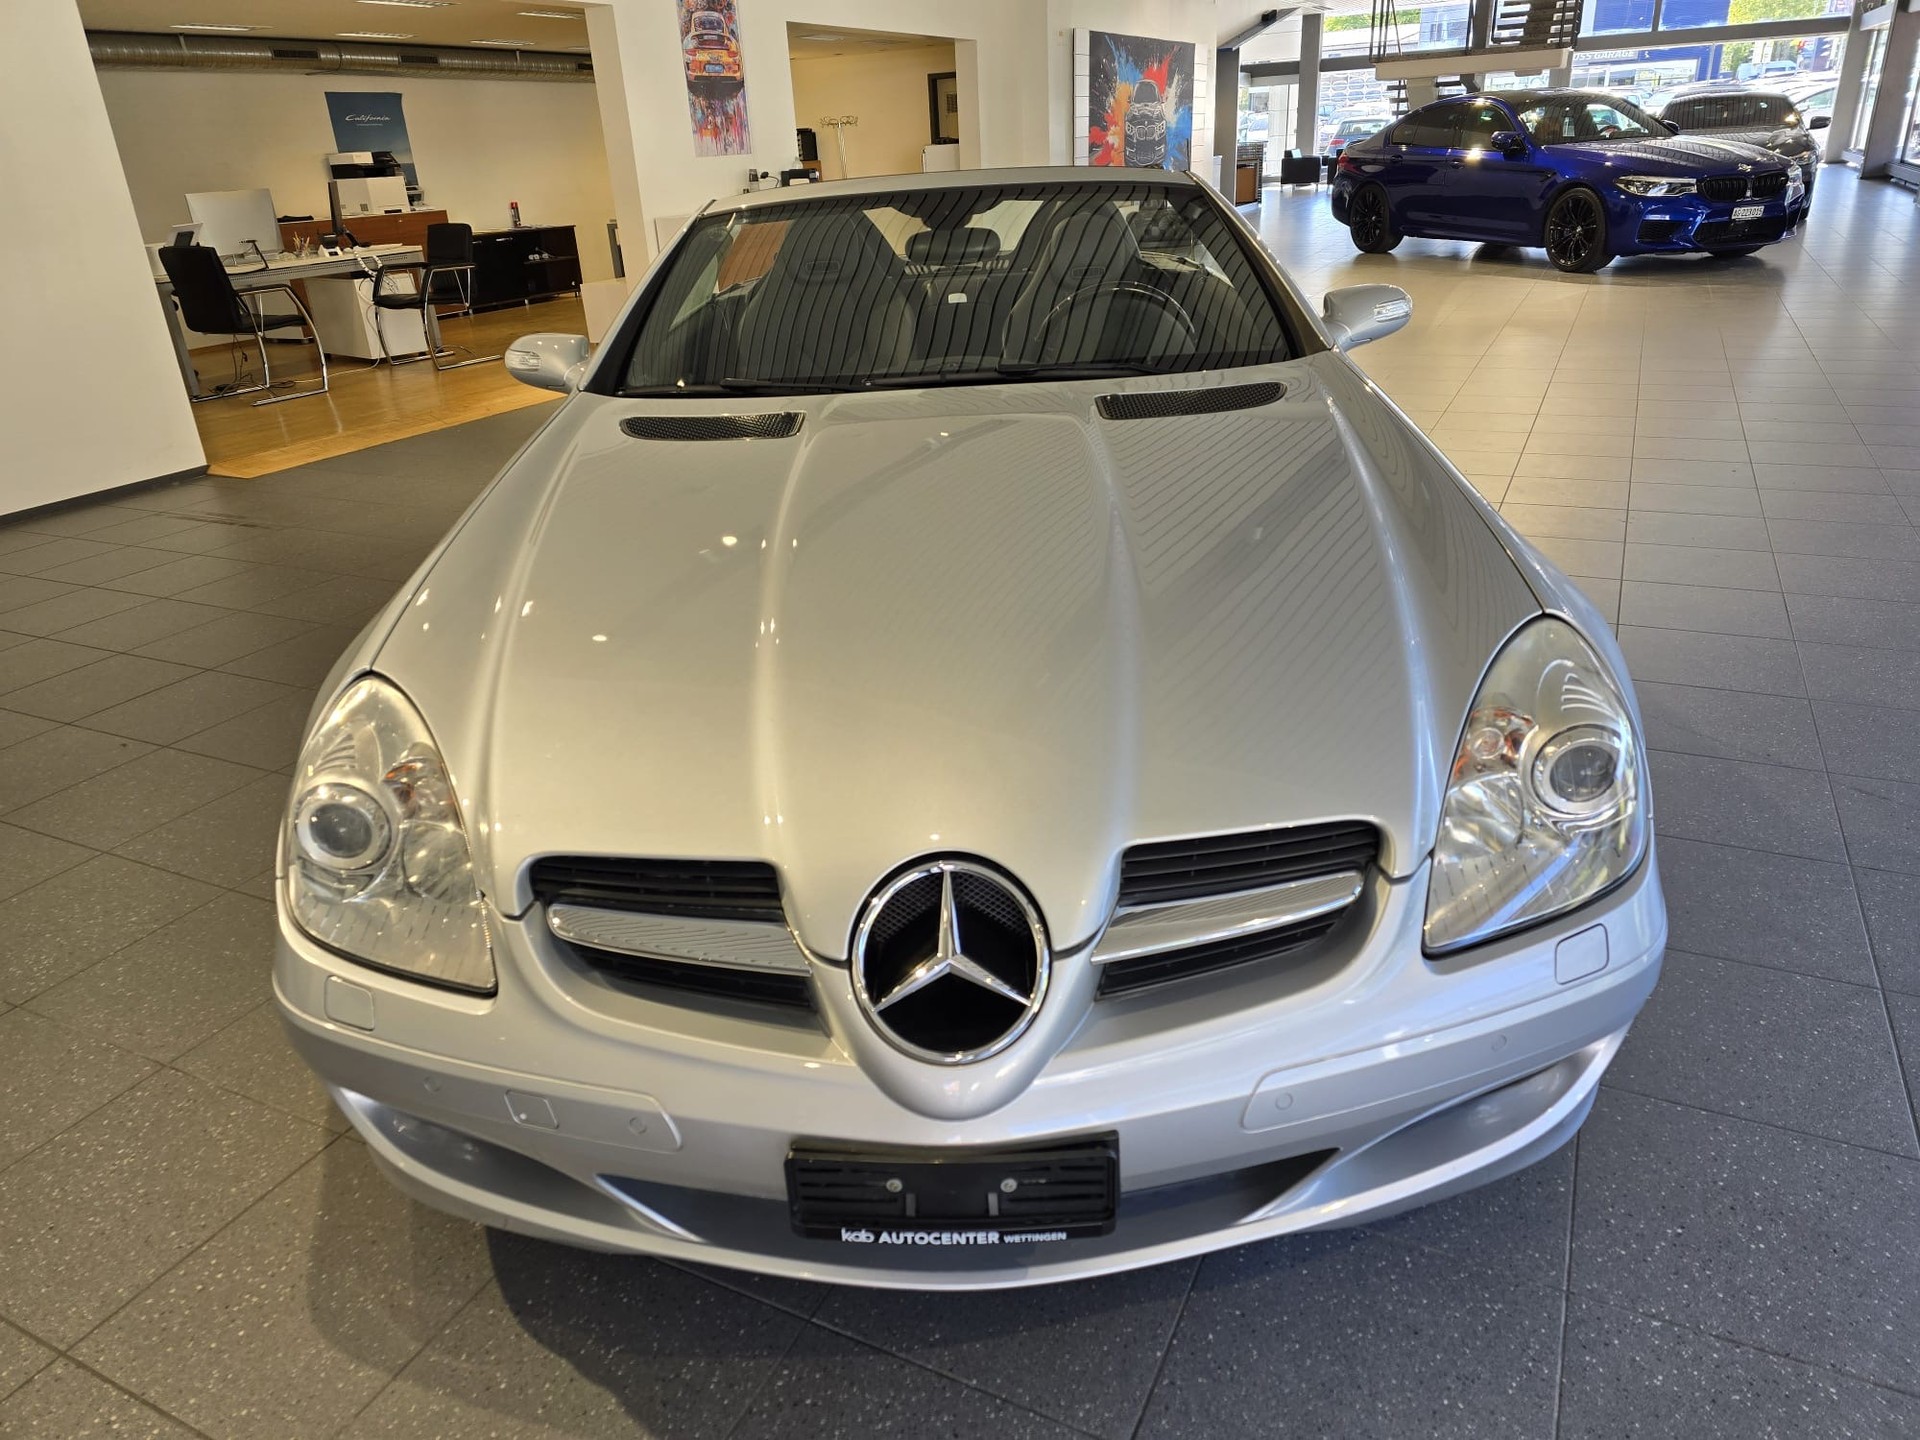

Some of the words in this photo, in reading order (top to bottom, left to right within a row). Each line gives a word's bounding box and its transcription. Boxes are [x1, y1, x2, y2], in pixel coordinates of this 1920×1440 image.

[1594, 50, 1634, 60] GARAGE
[345, 113, 391, 122] California
[878, 1231, 1000, 1245] AUTOCENTER
[1003, 1232, 1067, 1244] WETTINGEN
